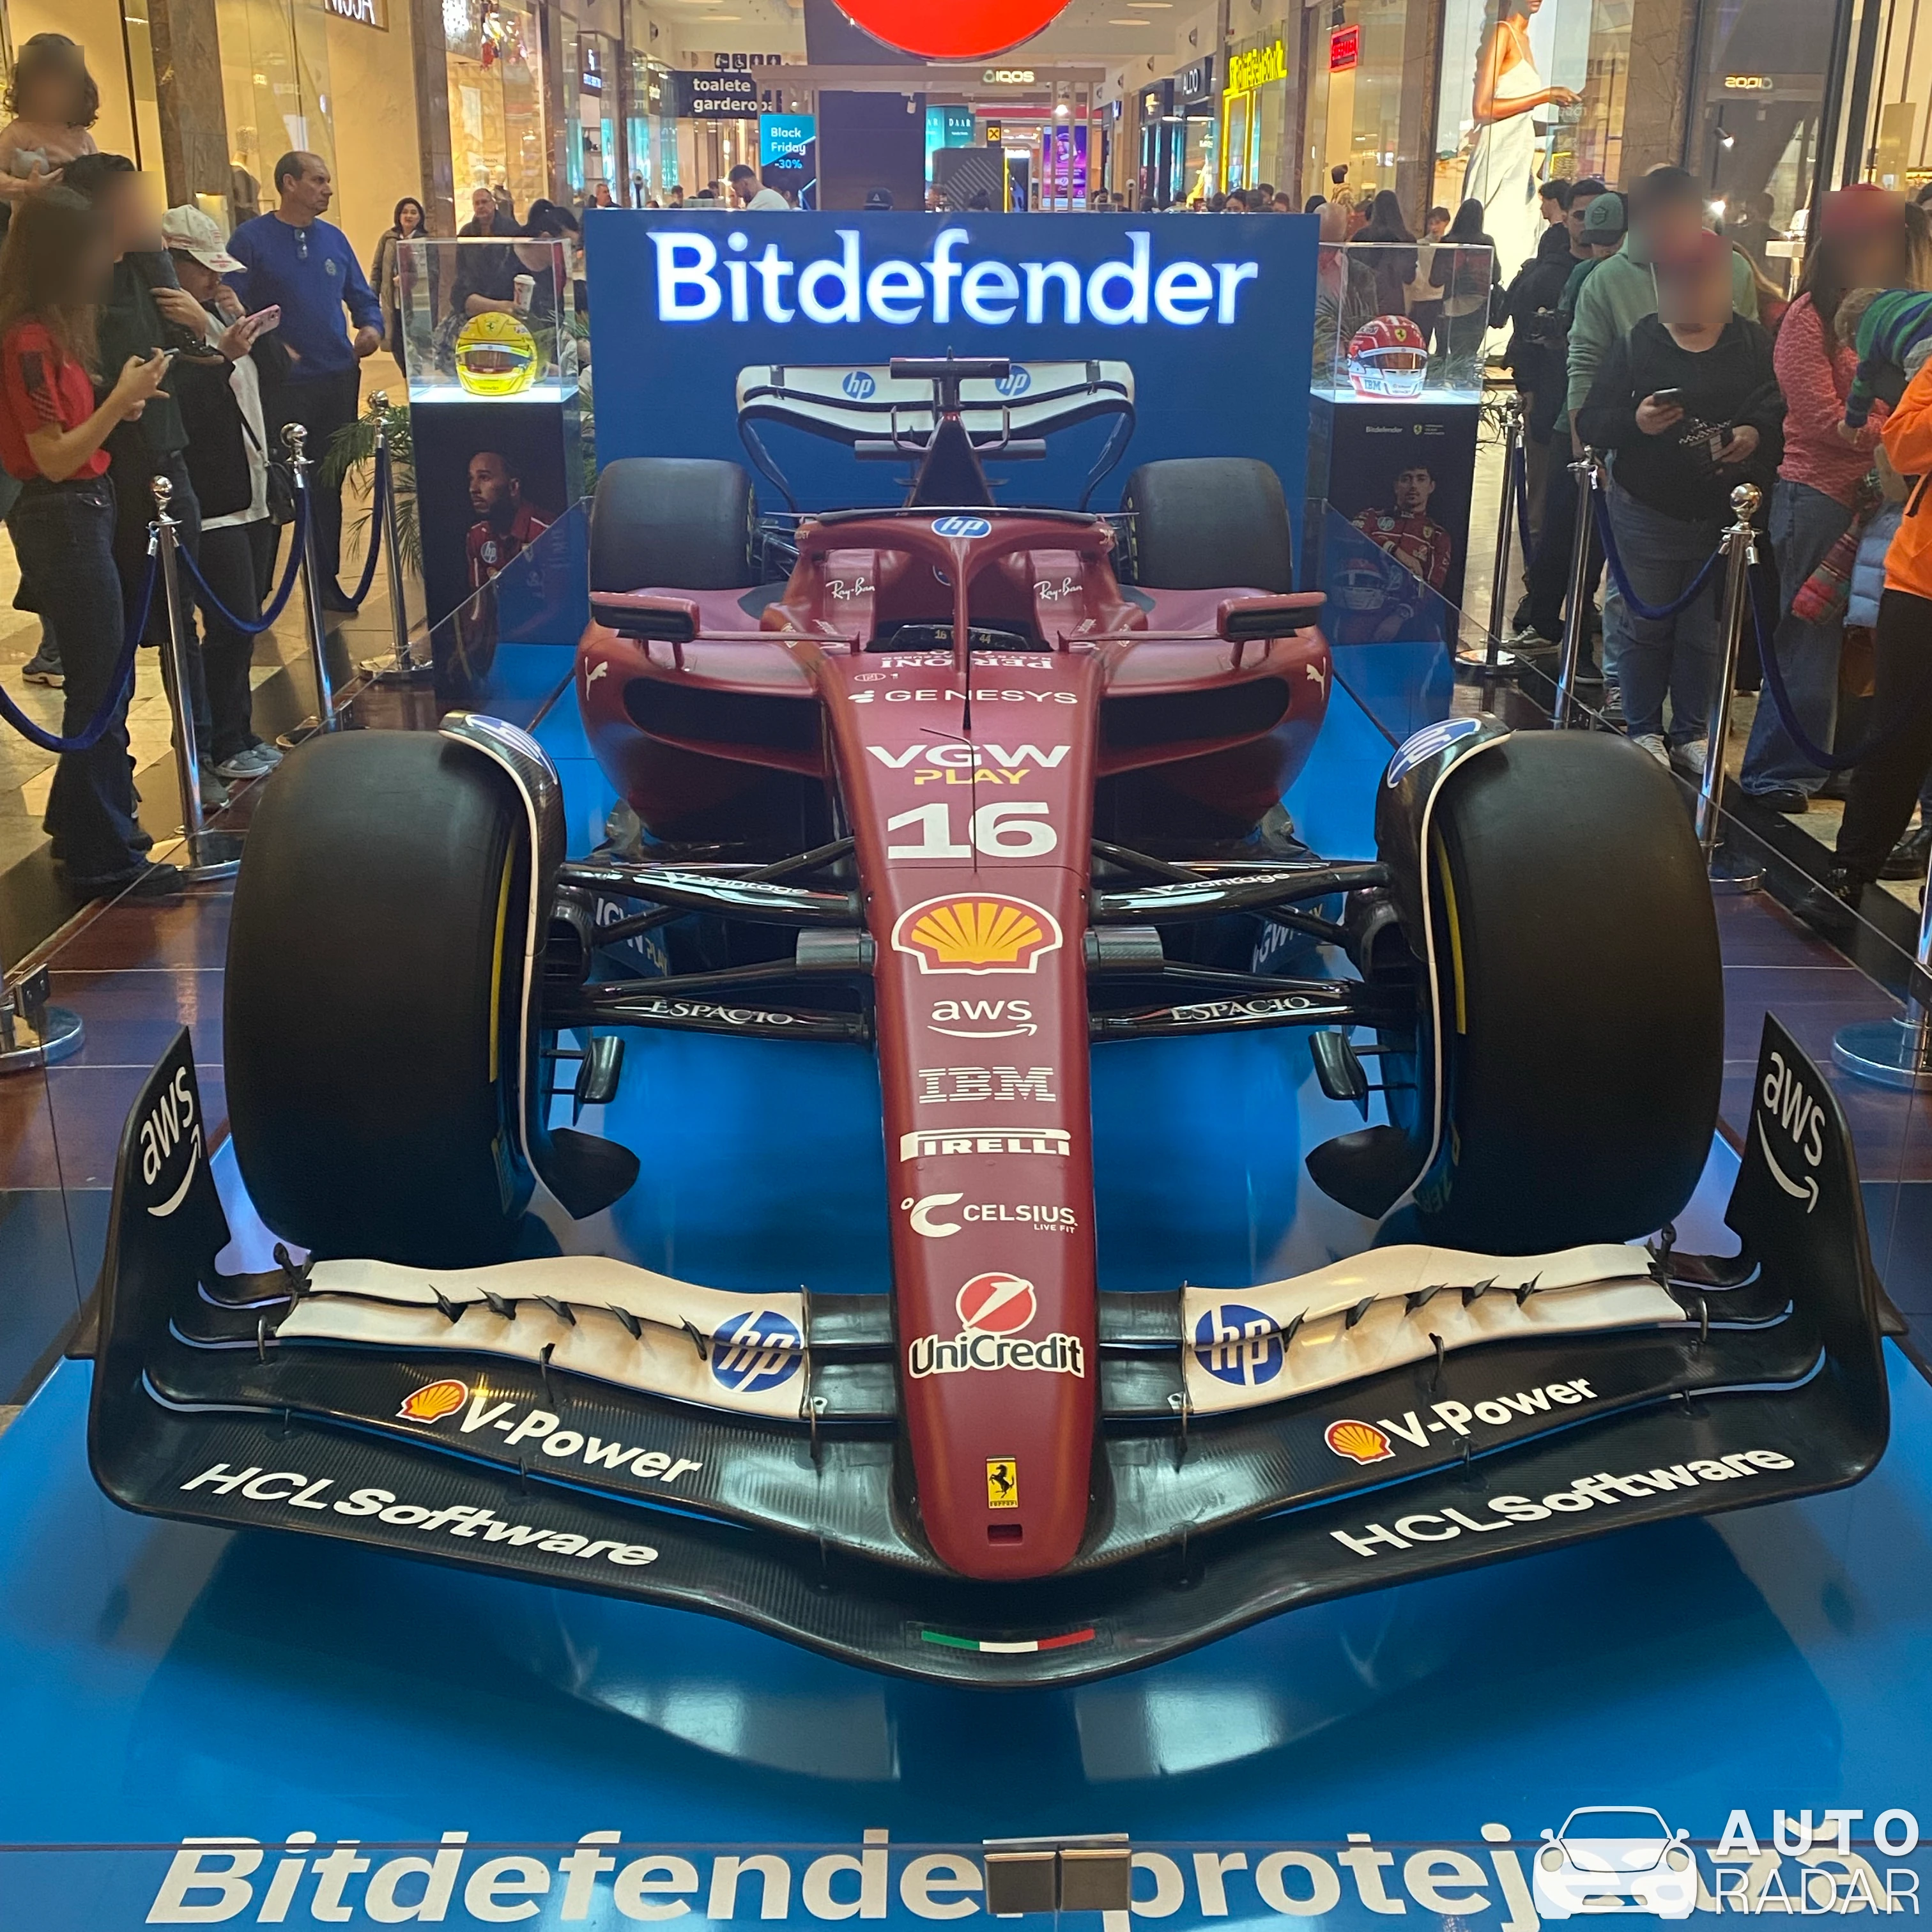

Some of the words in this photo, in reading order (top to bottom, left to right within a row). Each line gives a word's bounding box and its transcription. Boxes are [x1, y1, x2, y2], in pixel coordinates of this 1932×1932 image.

[693, 79, 751, 91] toalete
[995, 71, 1034, 83] IQOS
[1183, 68, 1199, 95] ALDO
[771, 128, 801, 137] Black
[949, 118, 971, 126] DAAR
[771, 142, 806, 155] Friday
[775, 160, 803, 169] -30%
[646, 228, 1259, 325] Bitdefender
[845, 371, 874, 399] hp
[1365, 379, 1381, 390] IBM
[939, 516, 985, 537] hp
[826, 577, 875, 601] Ray-Ban
[1033, 577, 1082, 601] Ray-Ban
[935, 629, 947, 640] 16
[885, 690, 1078, 704] GENESYS
[866, 744, 1071, 768] VGW
[914, 769, 1031, 785] PLAY
[887, 802, 1057, 859] 16
[650, 1001, 794, 1025] ESPACIO
[931, 1000, 1032, 1021] aws
[1169, 997, 1312, 1021] ESPACIO
[918, 1066, 1056, 1104] IBM
[1763, 1052, 1825, 1167] aws
[140, 1066, 194, 1186] aws
[900, 1127, 1071, 1163] PIRELLI
[963, 1204, 1077, 1225] CELSIUS
[1034, 1223, 1057, 1232] LIVE
[1059, 1225, 1075, 1234] FIT
[714, 1310, 797, 1392] hp
[911, 1333, 1082, 1375] UniCredit
[1208, 1303, 1274, 1386] hp
[1376, 1375, 1599, 1448] V-Power
[457, 1395, 704, 1483] V-Power
[145, 1828, 1025, 1924] Bitdefende
